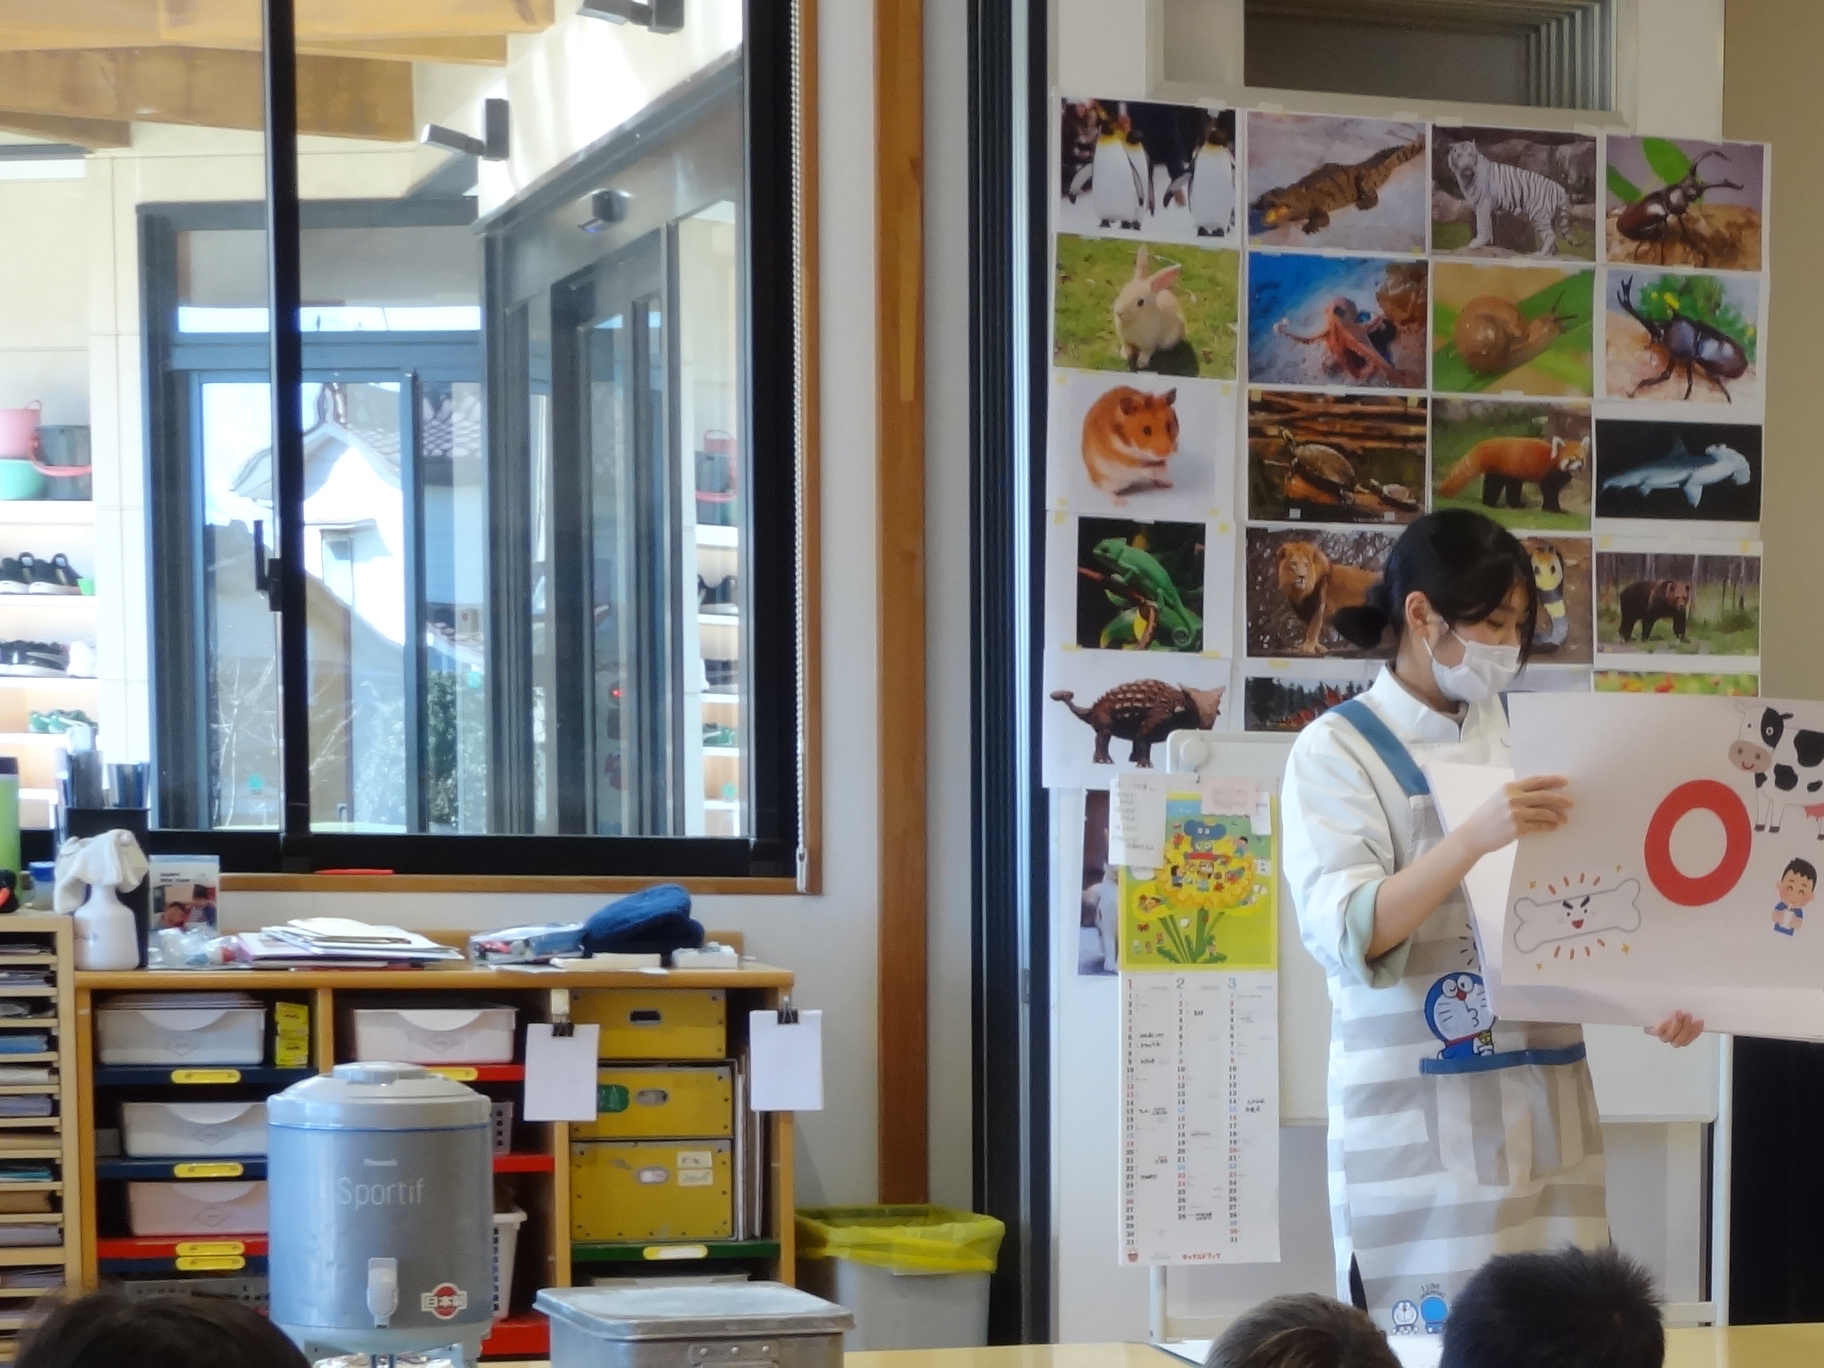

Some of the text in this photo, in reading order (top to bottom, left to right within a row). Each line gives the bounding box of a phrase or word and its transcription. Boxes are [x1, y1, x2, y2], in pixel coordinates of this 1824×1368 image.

[1127, 978, 1133, 989] 1
[1176, 977, 1185, 989] 2
[1228, 977, 1237, 989] 3
[338, 1176, 424, 1210] Sportif
